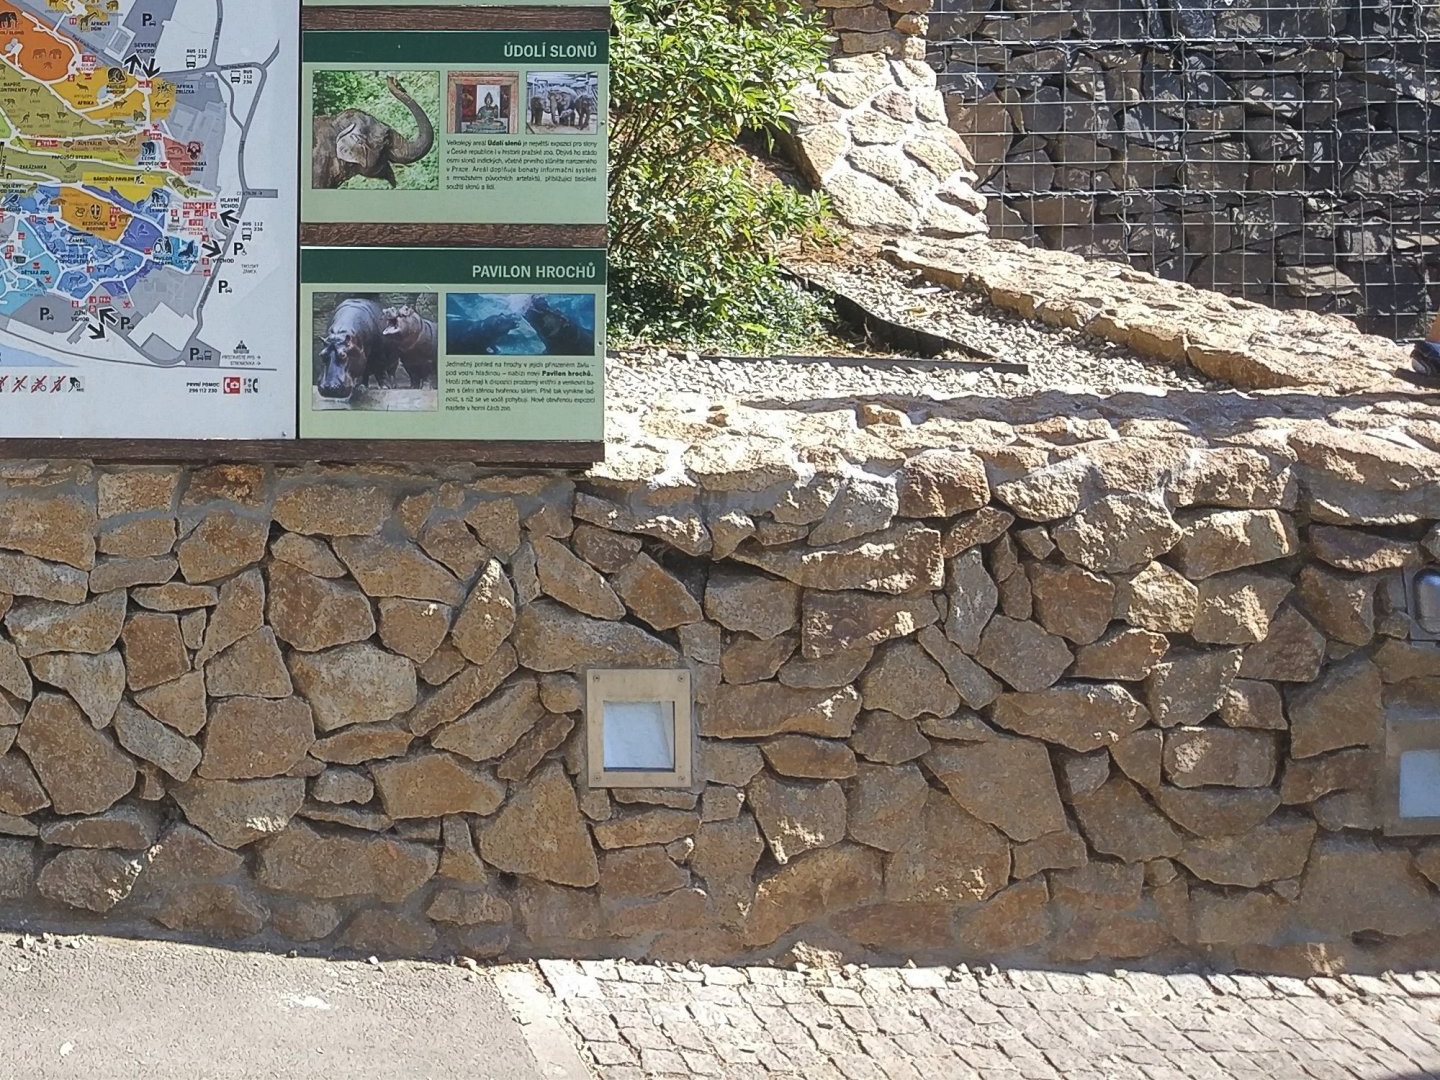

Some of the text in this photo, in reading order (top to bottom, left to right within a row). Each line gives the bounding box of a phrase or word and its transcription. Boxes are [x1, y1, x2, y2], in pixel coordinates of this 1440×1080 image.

[142, 14, 152, 26] P
[504, 41, 597, 58] ÚDOLÍ SLONŮ
[234, 243, 243, 255] P
[472, 261, 596, 279] PAVILON HROCHŮ
[218, 281, 228, 293] P
[40, 308, 50, 320] P
[121, 317, 131, 329] P
[190, 348, 199, 360] P
